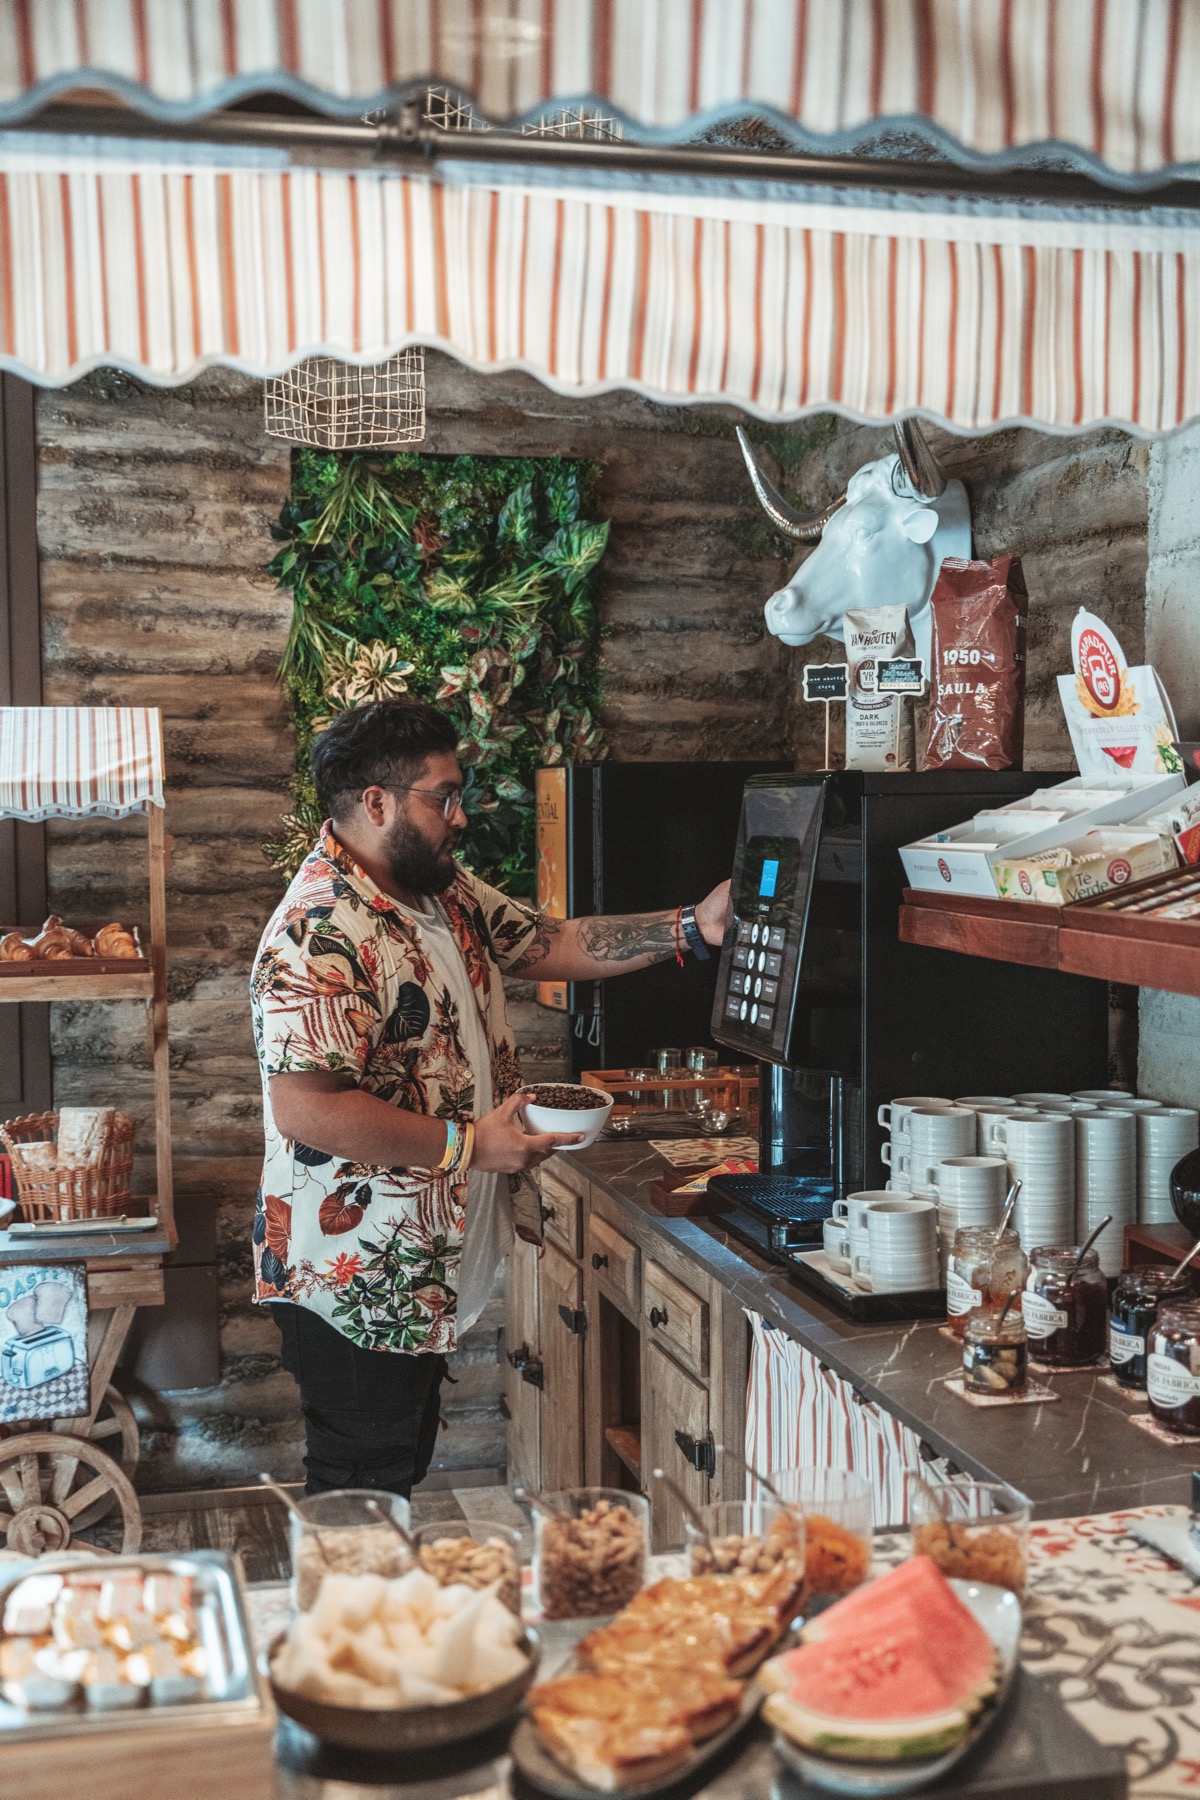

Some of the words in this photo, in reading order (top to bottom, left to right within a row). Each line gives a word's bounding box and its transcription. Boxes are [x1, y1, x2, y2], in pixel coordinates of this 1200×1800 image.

[851, 633, 863, 647] VAN
[864, 631, 897, 646] HOUTEN
[943, 649, 981, 666] 1950
[1079, 634, 1117, 678] POMPADOUR
[938, 682, 985, 696] SAULA
[1066, 879, 1110, 901] Verde
[1031, 1311, 1063, 1323] FABRICA
[1162, 1376, 1200, 1390] FABRICA
